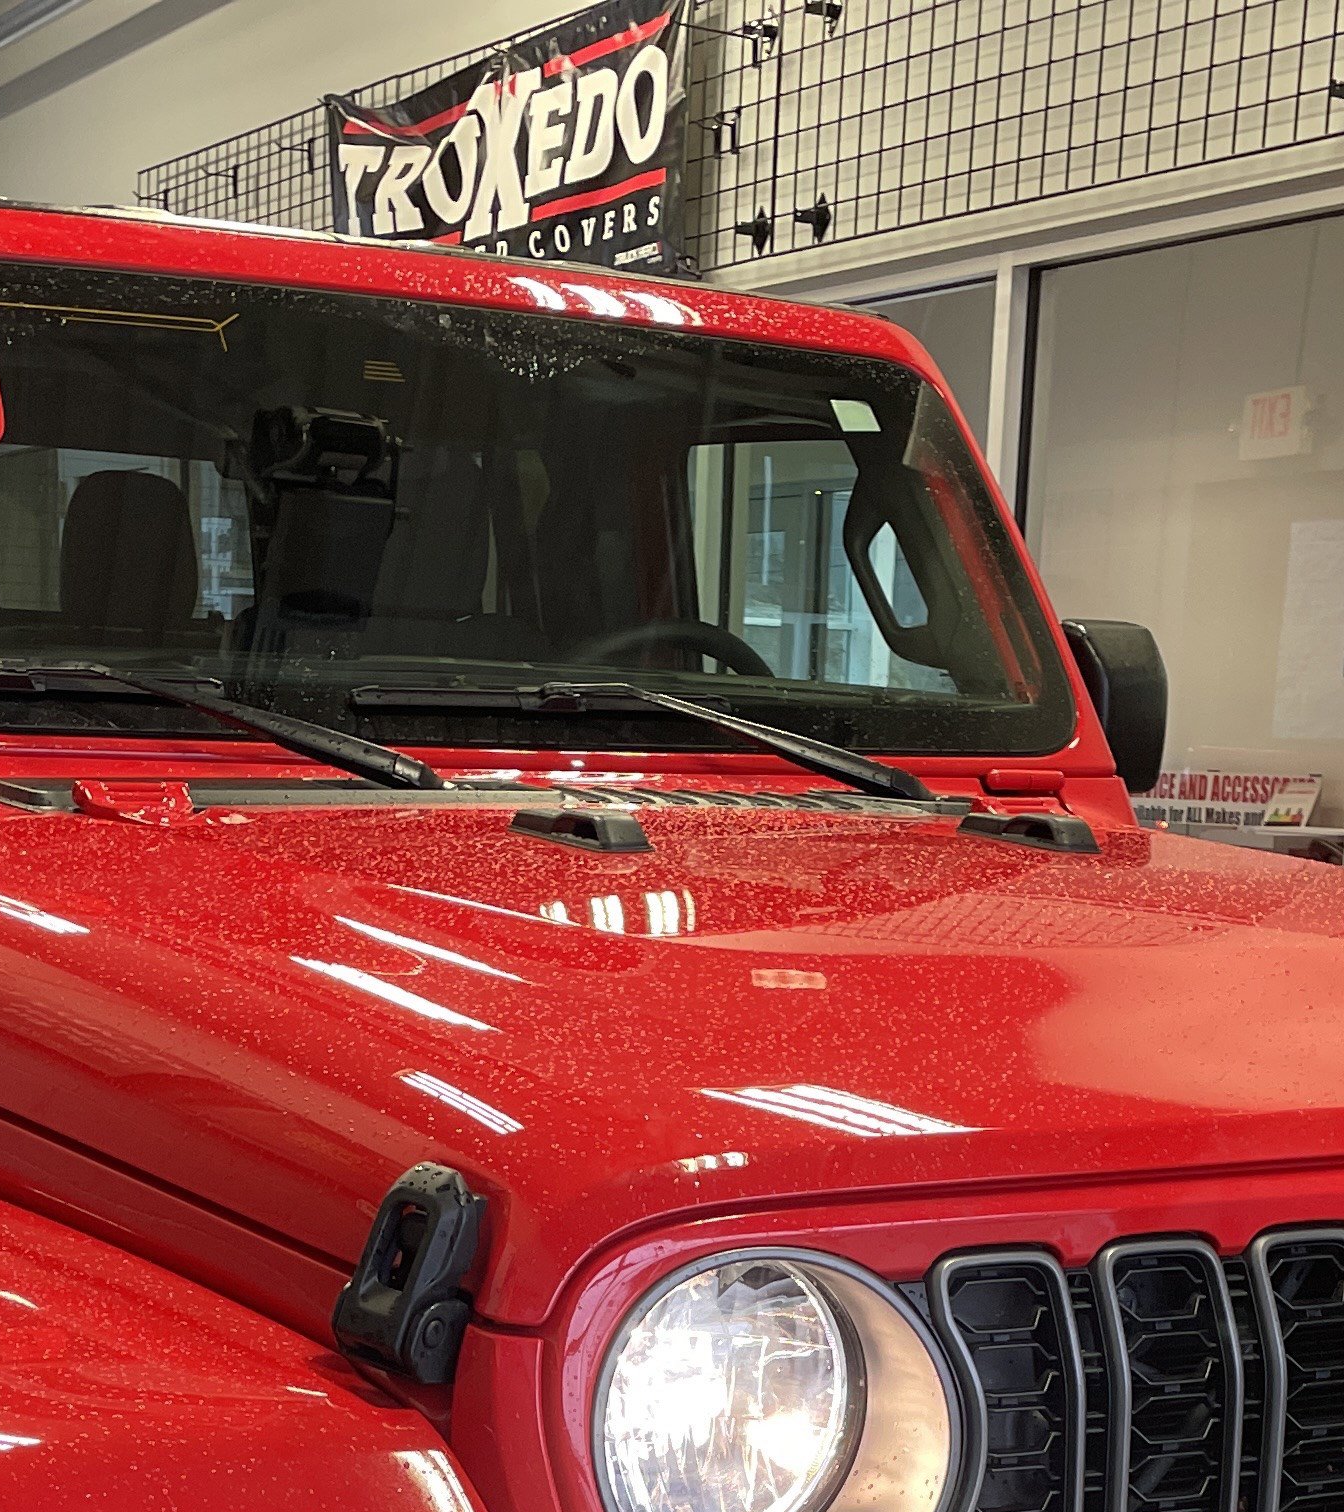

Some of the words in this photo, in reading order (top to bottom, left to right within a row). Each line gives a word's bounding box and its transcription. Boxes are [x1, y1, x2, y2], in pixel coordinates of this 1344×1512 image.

[528, 196, 662, 258] COVERS
[1178, 774, 1208, 801] AND
[1186, 807, 1202, 823] ALL
[1205, 808, 1242, 824] Makes
